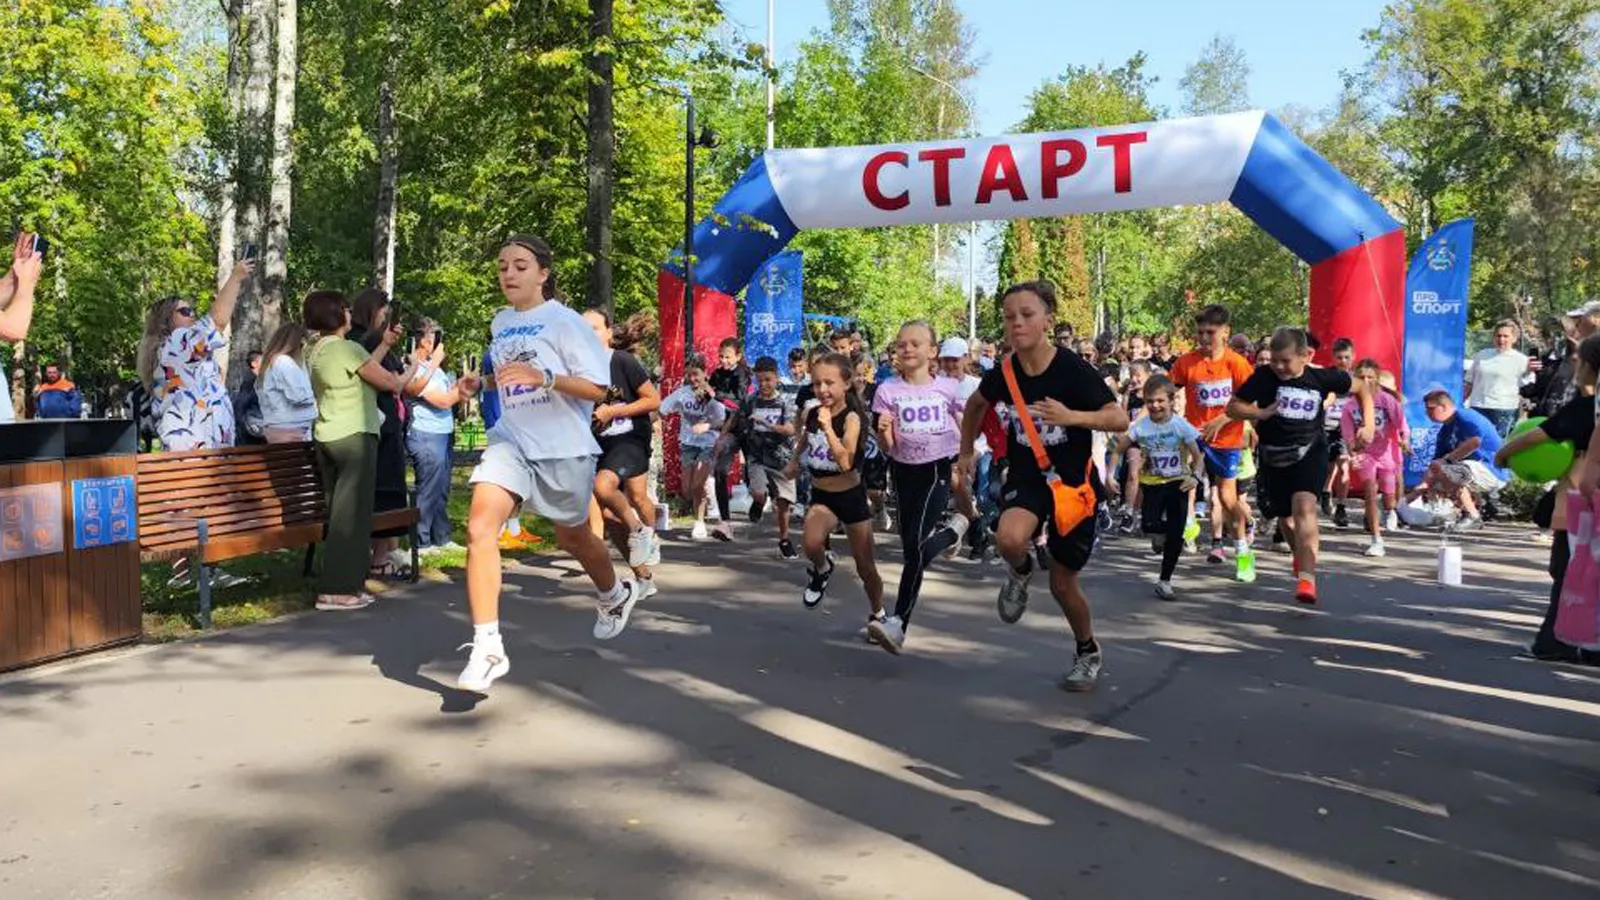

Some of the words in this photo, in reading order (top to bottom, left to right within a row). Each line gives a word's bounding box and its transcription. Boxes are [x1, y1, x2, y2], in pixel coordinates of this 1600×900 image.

[862, 131, 1148, 211] СТАРТ
[1415, 292, 1437, 302] ПРО
[1413, 302, 1462, 315] СПОРТ
[752, 322, 796, 335] СПОРТ
[902, 405, 941, 423] 081
[1152, 455, 1179, 469] 170
